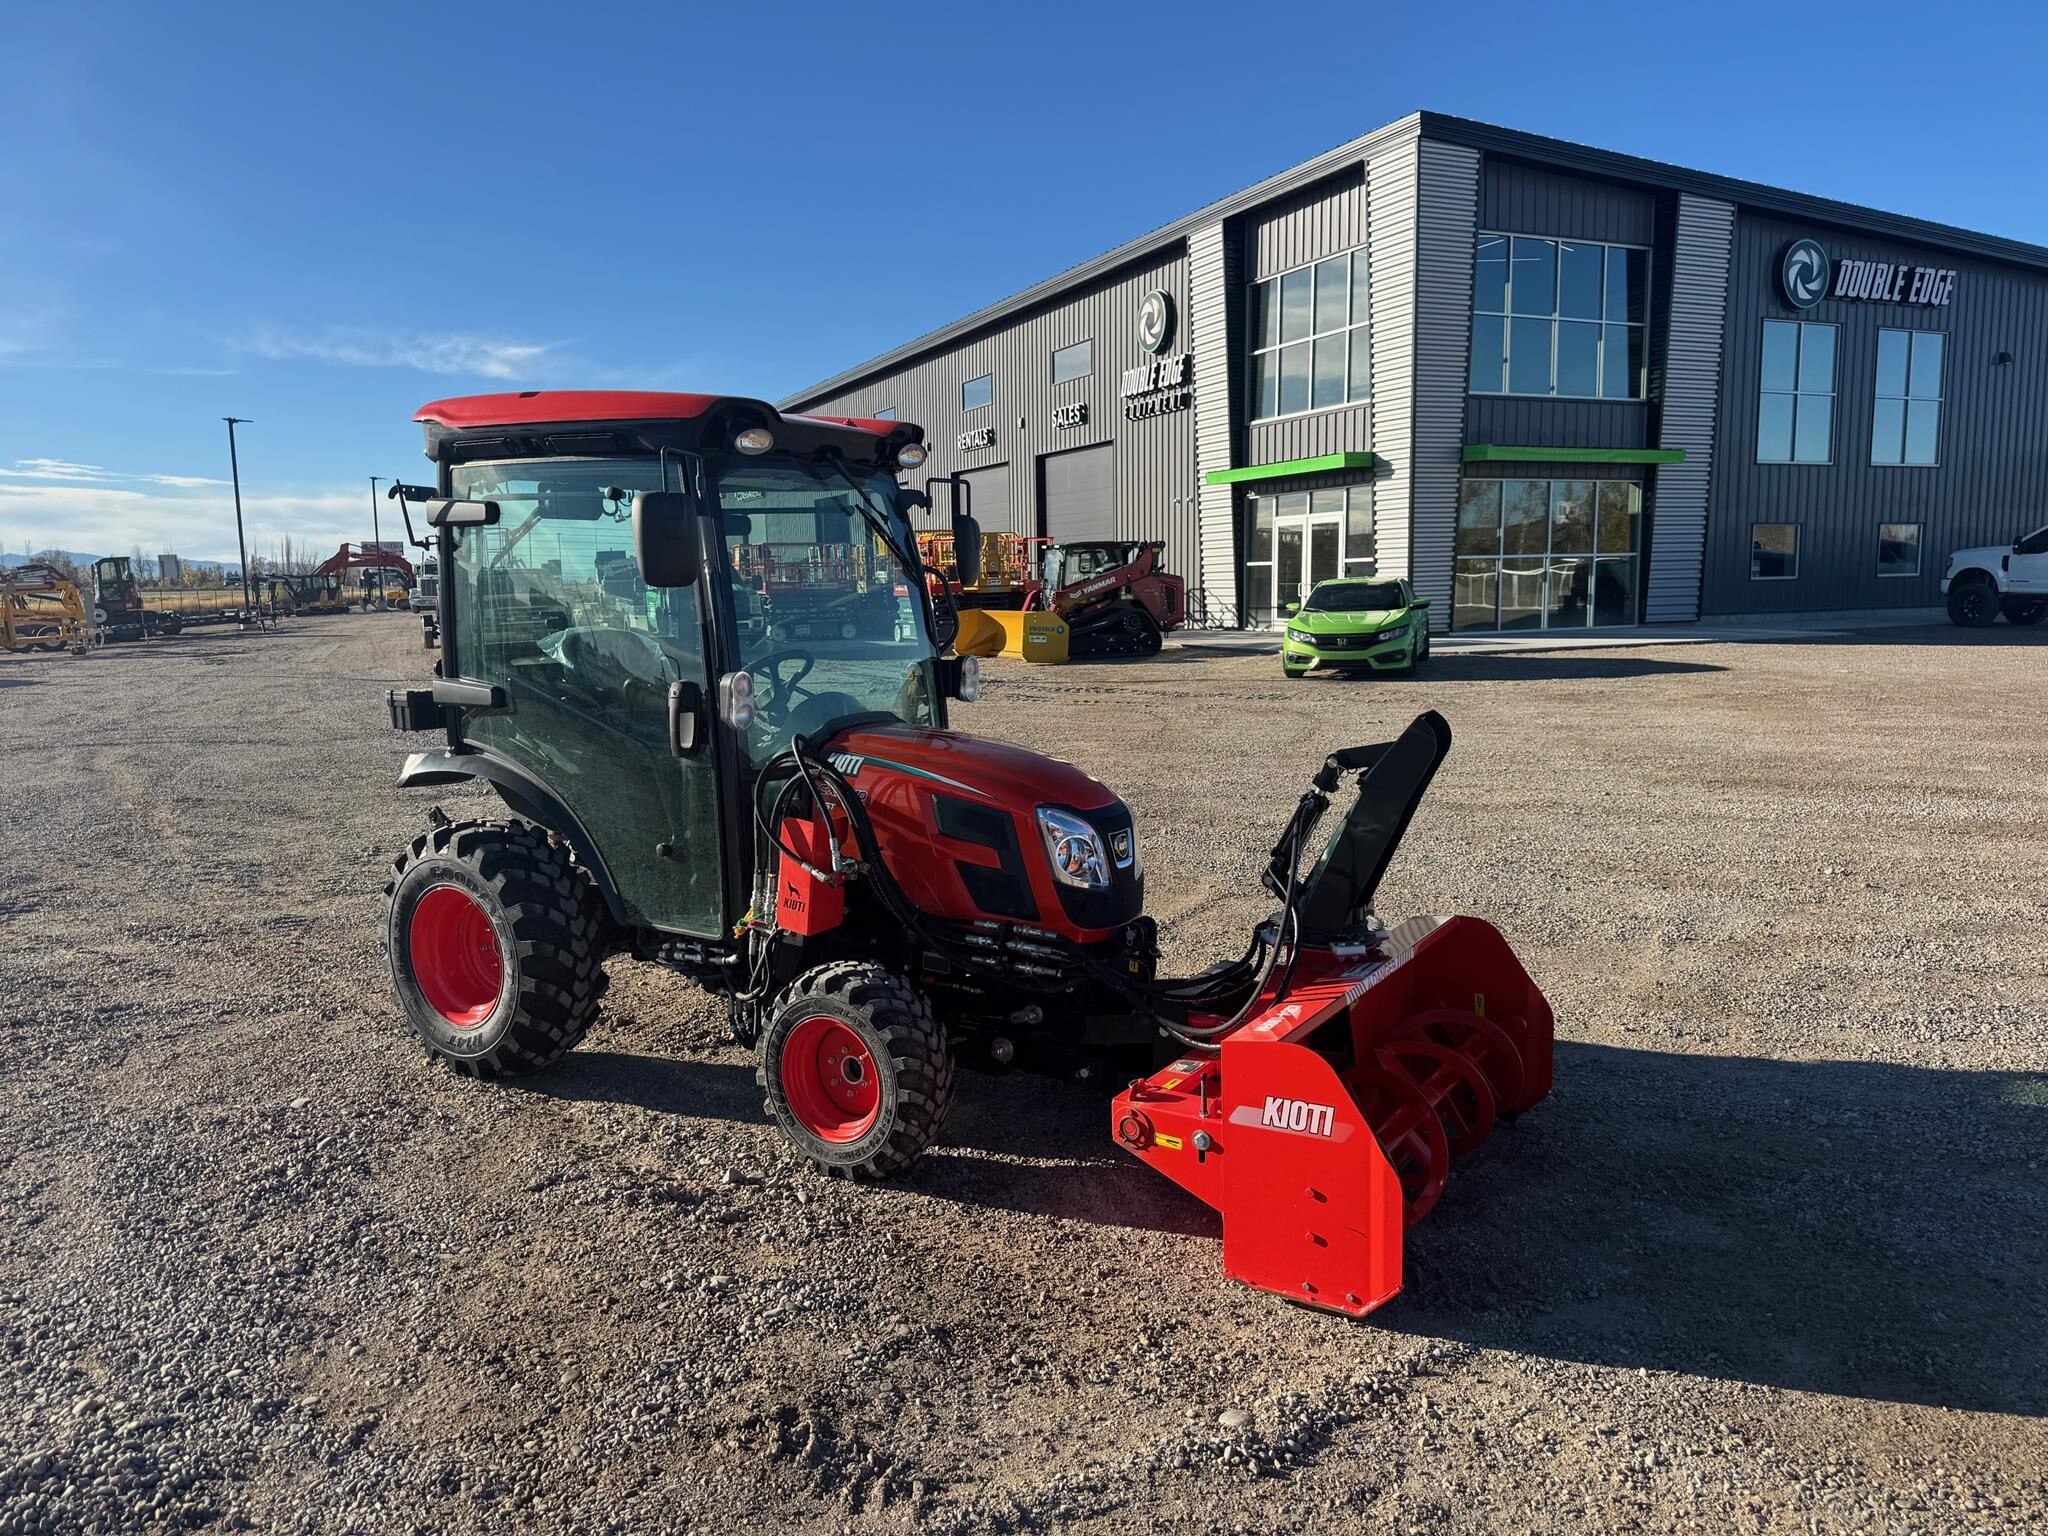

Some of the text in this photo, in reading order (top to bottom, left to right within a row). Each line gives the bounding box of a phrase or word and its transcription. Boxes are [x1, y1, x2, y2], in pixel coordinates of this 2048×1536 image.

[1834, 259, 1957, 306] DOUBLE EDGE
[1120, 353, 1186, 397] DOUBLE EDGE
[1051, 402, 1082, 428] SALES
[1124, 393, 1182, 420] EQUIPMENT
[957, 427, 989, 451] RENTALS
[1082, 576, 1116, 594] YANMAR
[783, 897, 806, 913] KIOTI
[1261, 1094, 1336, 1138] KIOTI
